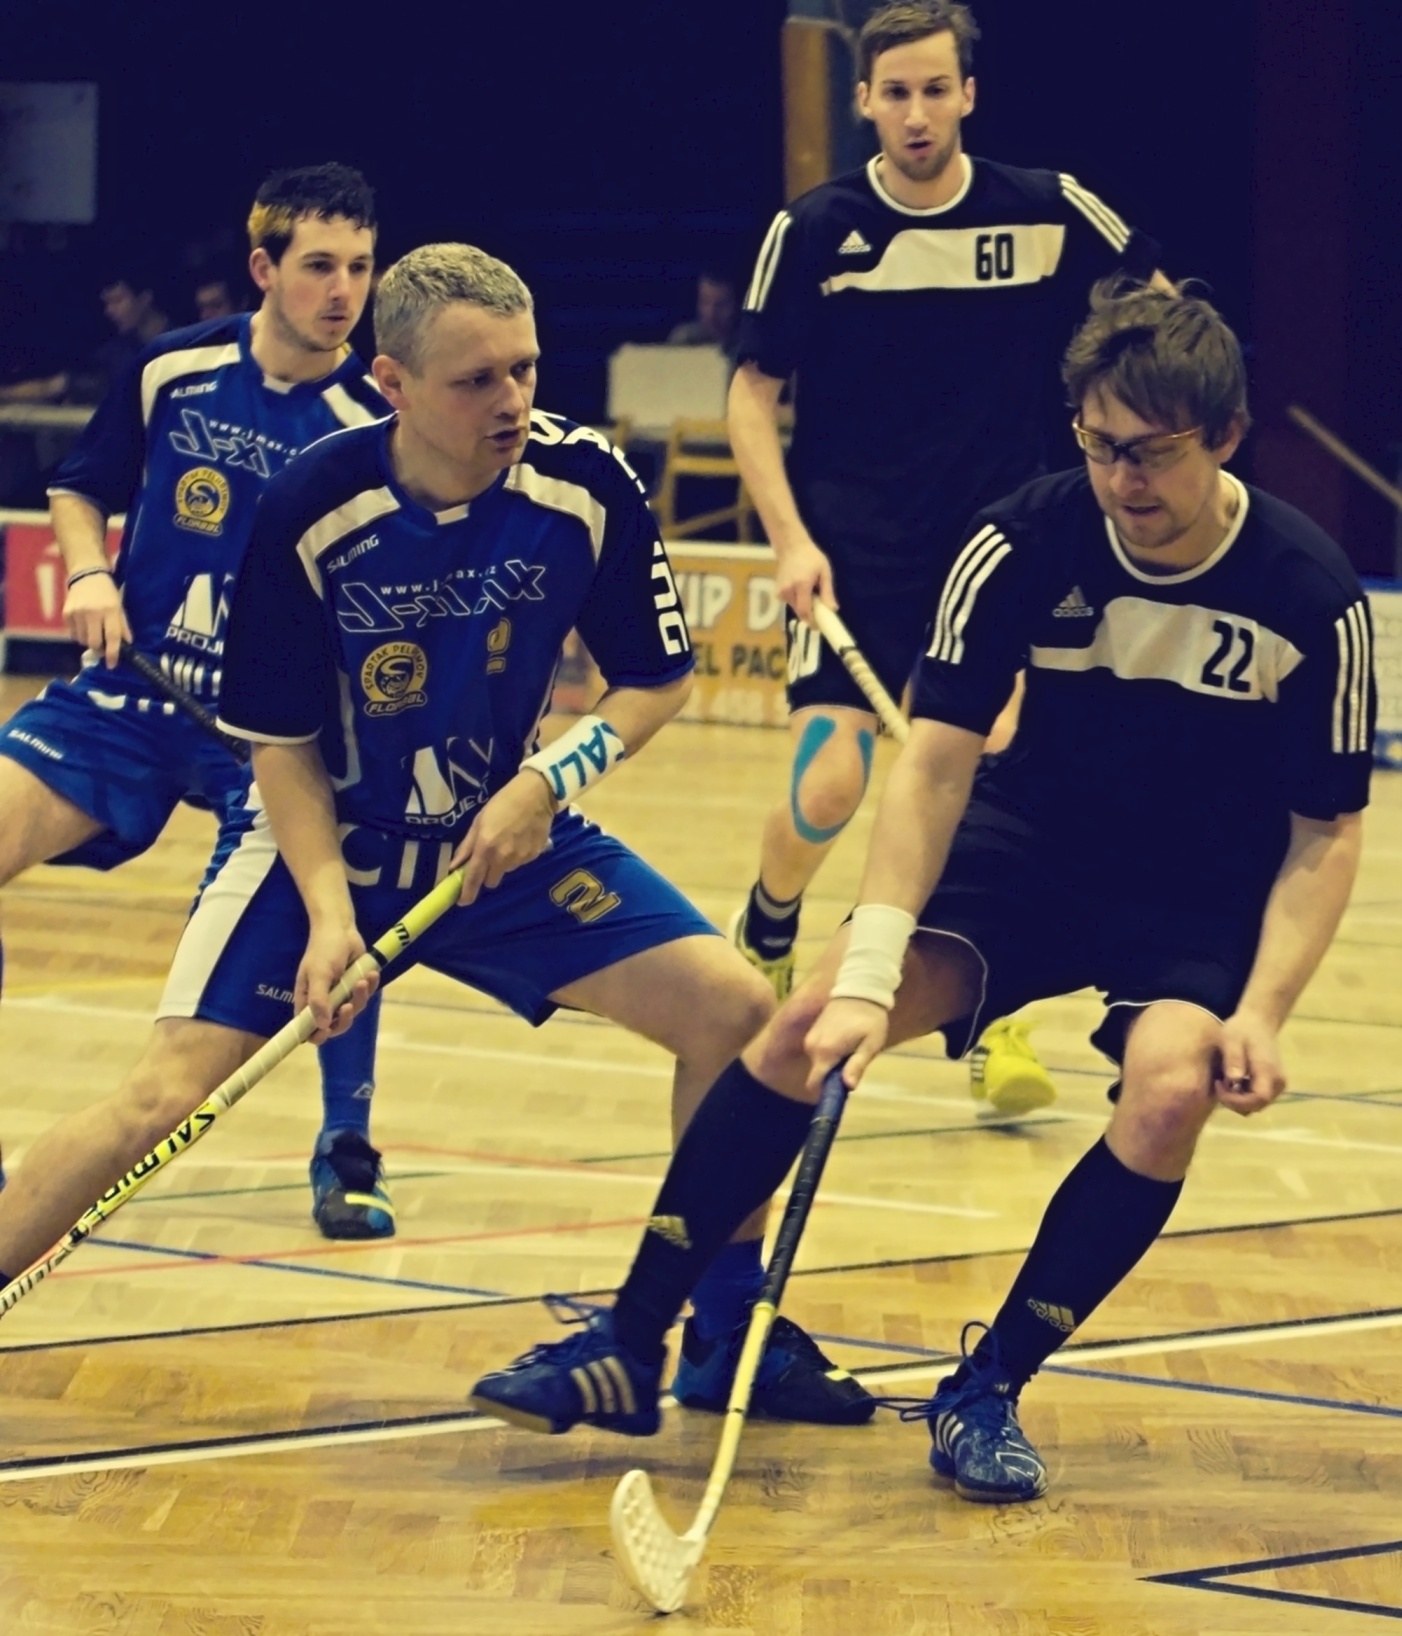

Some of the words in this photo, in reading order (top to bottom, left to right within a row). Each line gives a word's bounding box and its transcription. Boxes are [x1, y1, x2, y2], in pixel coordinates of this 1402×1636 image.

[975, 232, 1015, 282] 60
[208, 419, 298, 457] www.jmax.c
[1200, 618, 1255, 693] 22
[6, 728, 65, 760] SALMING
[548, 871, 622, 924] 2
